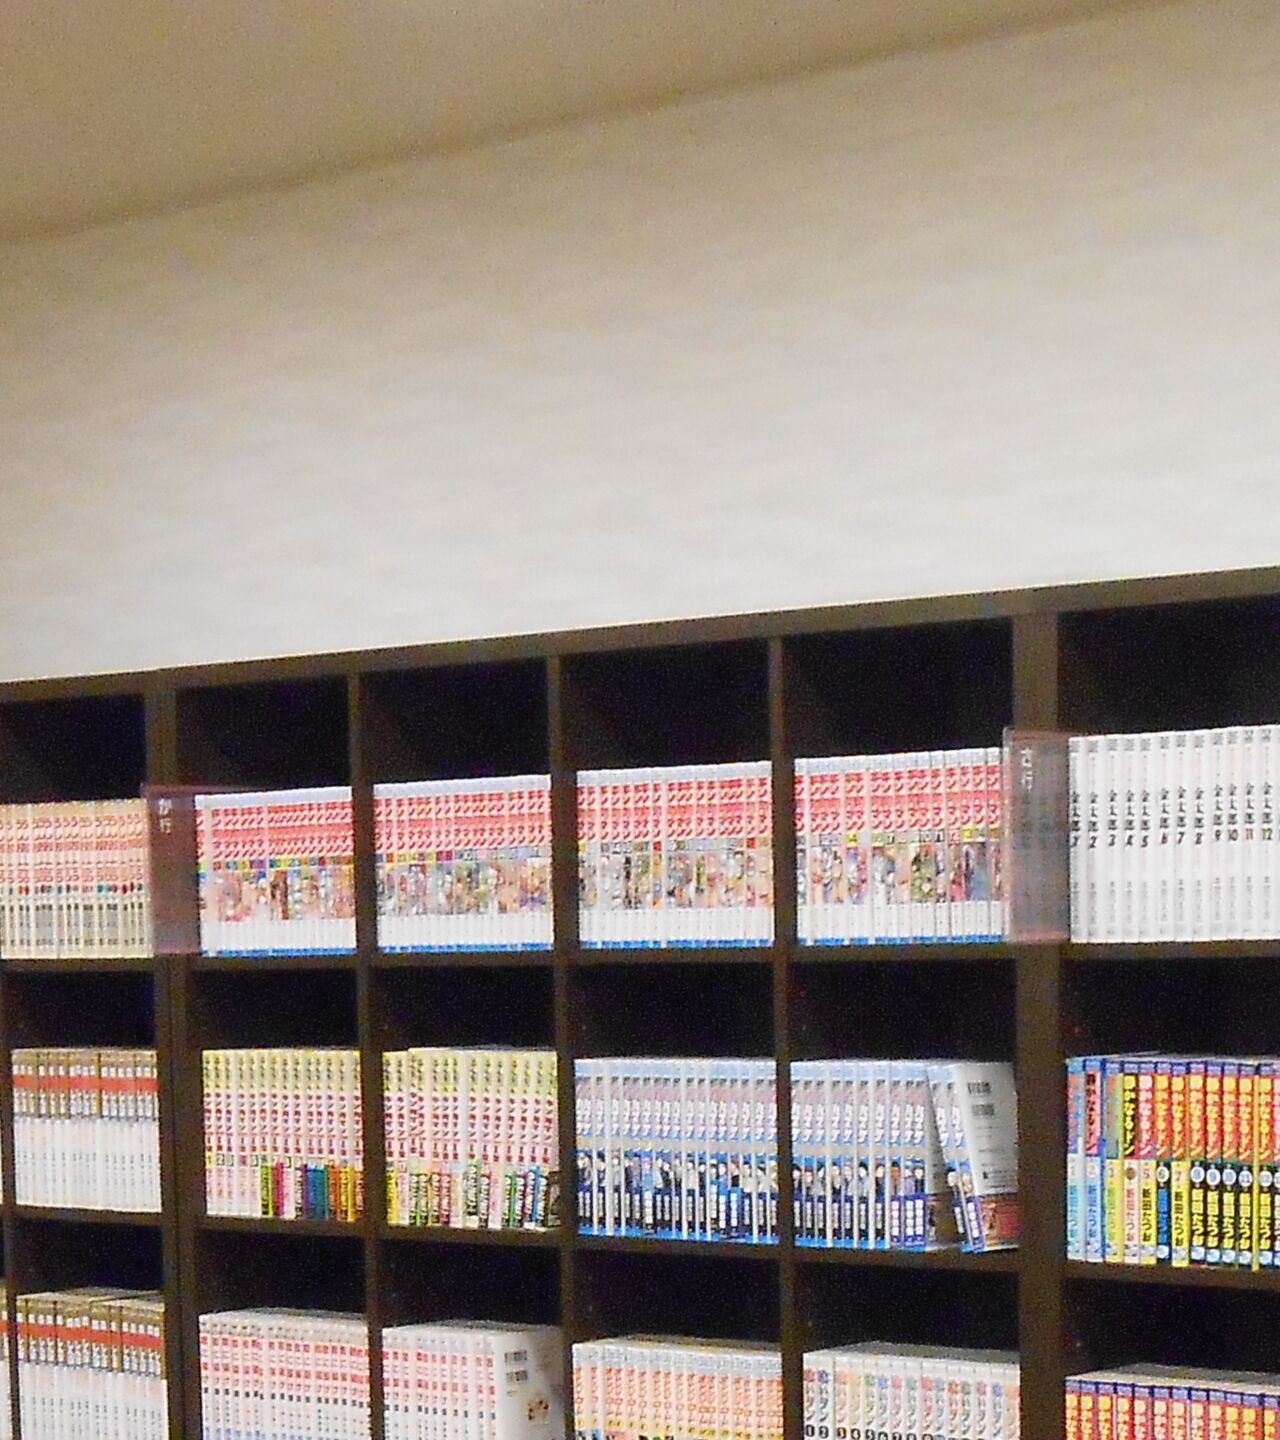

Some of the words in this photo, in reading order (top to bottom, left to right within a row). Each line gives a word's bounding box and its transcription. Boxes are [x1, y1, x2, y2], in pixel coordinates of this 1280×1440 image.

[1177, 832, 1184, 844] 7
[1215, 831, 1221, 841] 9
[1228, 829, 1237, 840] 10
[1245, 830, 1253, 840] 11
[1262, 828, 1272, 840] 12
[1073, 837, 1079, 847] 1
[1089, 837, 1096, 848] 2
[1109, 835, 1115, 846] 3
[1141, 836, 1148, 848] 5
